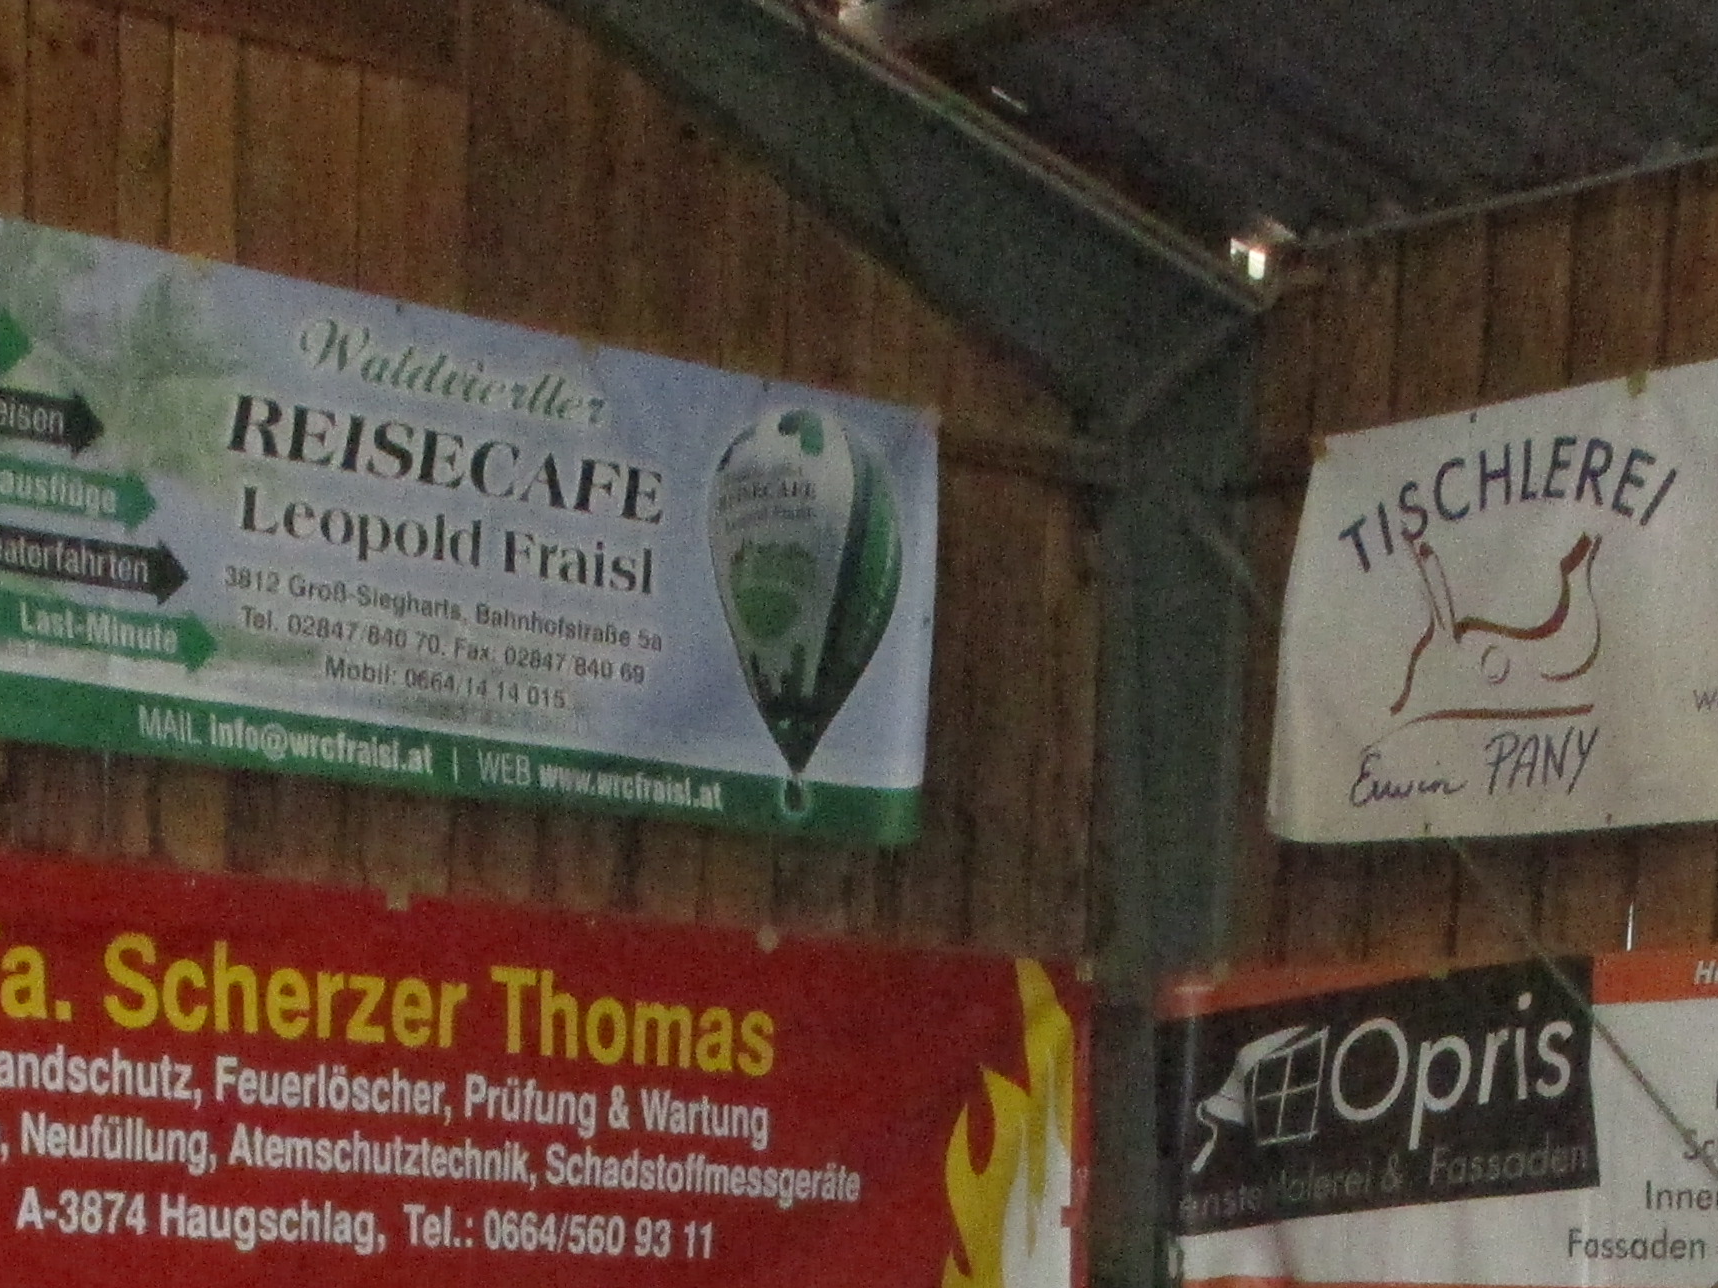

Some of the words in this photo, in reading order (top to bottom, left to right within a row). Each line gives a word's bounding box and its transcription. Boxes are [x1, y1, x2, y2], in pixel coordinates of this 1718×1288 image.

[228, 394, 664, 525] REISECAFE
[241, 486, 481, 567] Leopold
[503, 530, 654, 596] Fraisl
[1338, 435, 1679, 573] TISCHLEREI
[20, 602, 179, 654] Last-Minute
[225, 565, 281, 593] 3812
[475, 602, 632, 648] Bahnhofstraße
[242, 605, 278, 632] Tel.
[138, 705, 201, 746] MAIL
[478, 750, 532, 788] WEB
[1485, 726, 1599, 796] PANY
[102, 932, 470, 1049] Scherzer
[489, 965, 776, 1078] Thomas
[215, 1055, 452, 1126] Feuerlöscher,
[463, 1073, 597, 1140] Prüfung
[608, 1084, 631, 1131] &
[639, 1088, 770, 1151] Wartung
[1329, 990, 1575, 1151] Opris
[19, 1110, 218, 1176] Neufüllung,
[228, 1122, 539, 1191] Atemschutztechnik,
[544, 1141, 862, 1209] Schadstoffmessgeräte
[1380, 1152, 1404, 1193] &
[1427, 1133, 1587, 1190] Fassaden
[15, 1185, 146, 1236] A-3874
[158, 1192, 387, 1256] Haugschlag,
[401, 1202, 474, 1248] Tel.:
[483, 1208, 626, 1257] 0664/560
[633, 1216, 672, 1258] 93
[683, 1221, 714, 1261] 11
[1567, 1228, 1707, 1262] Fassaden
